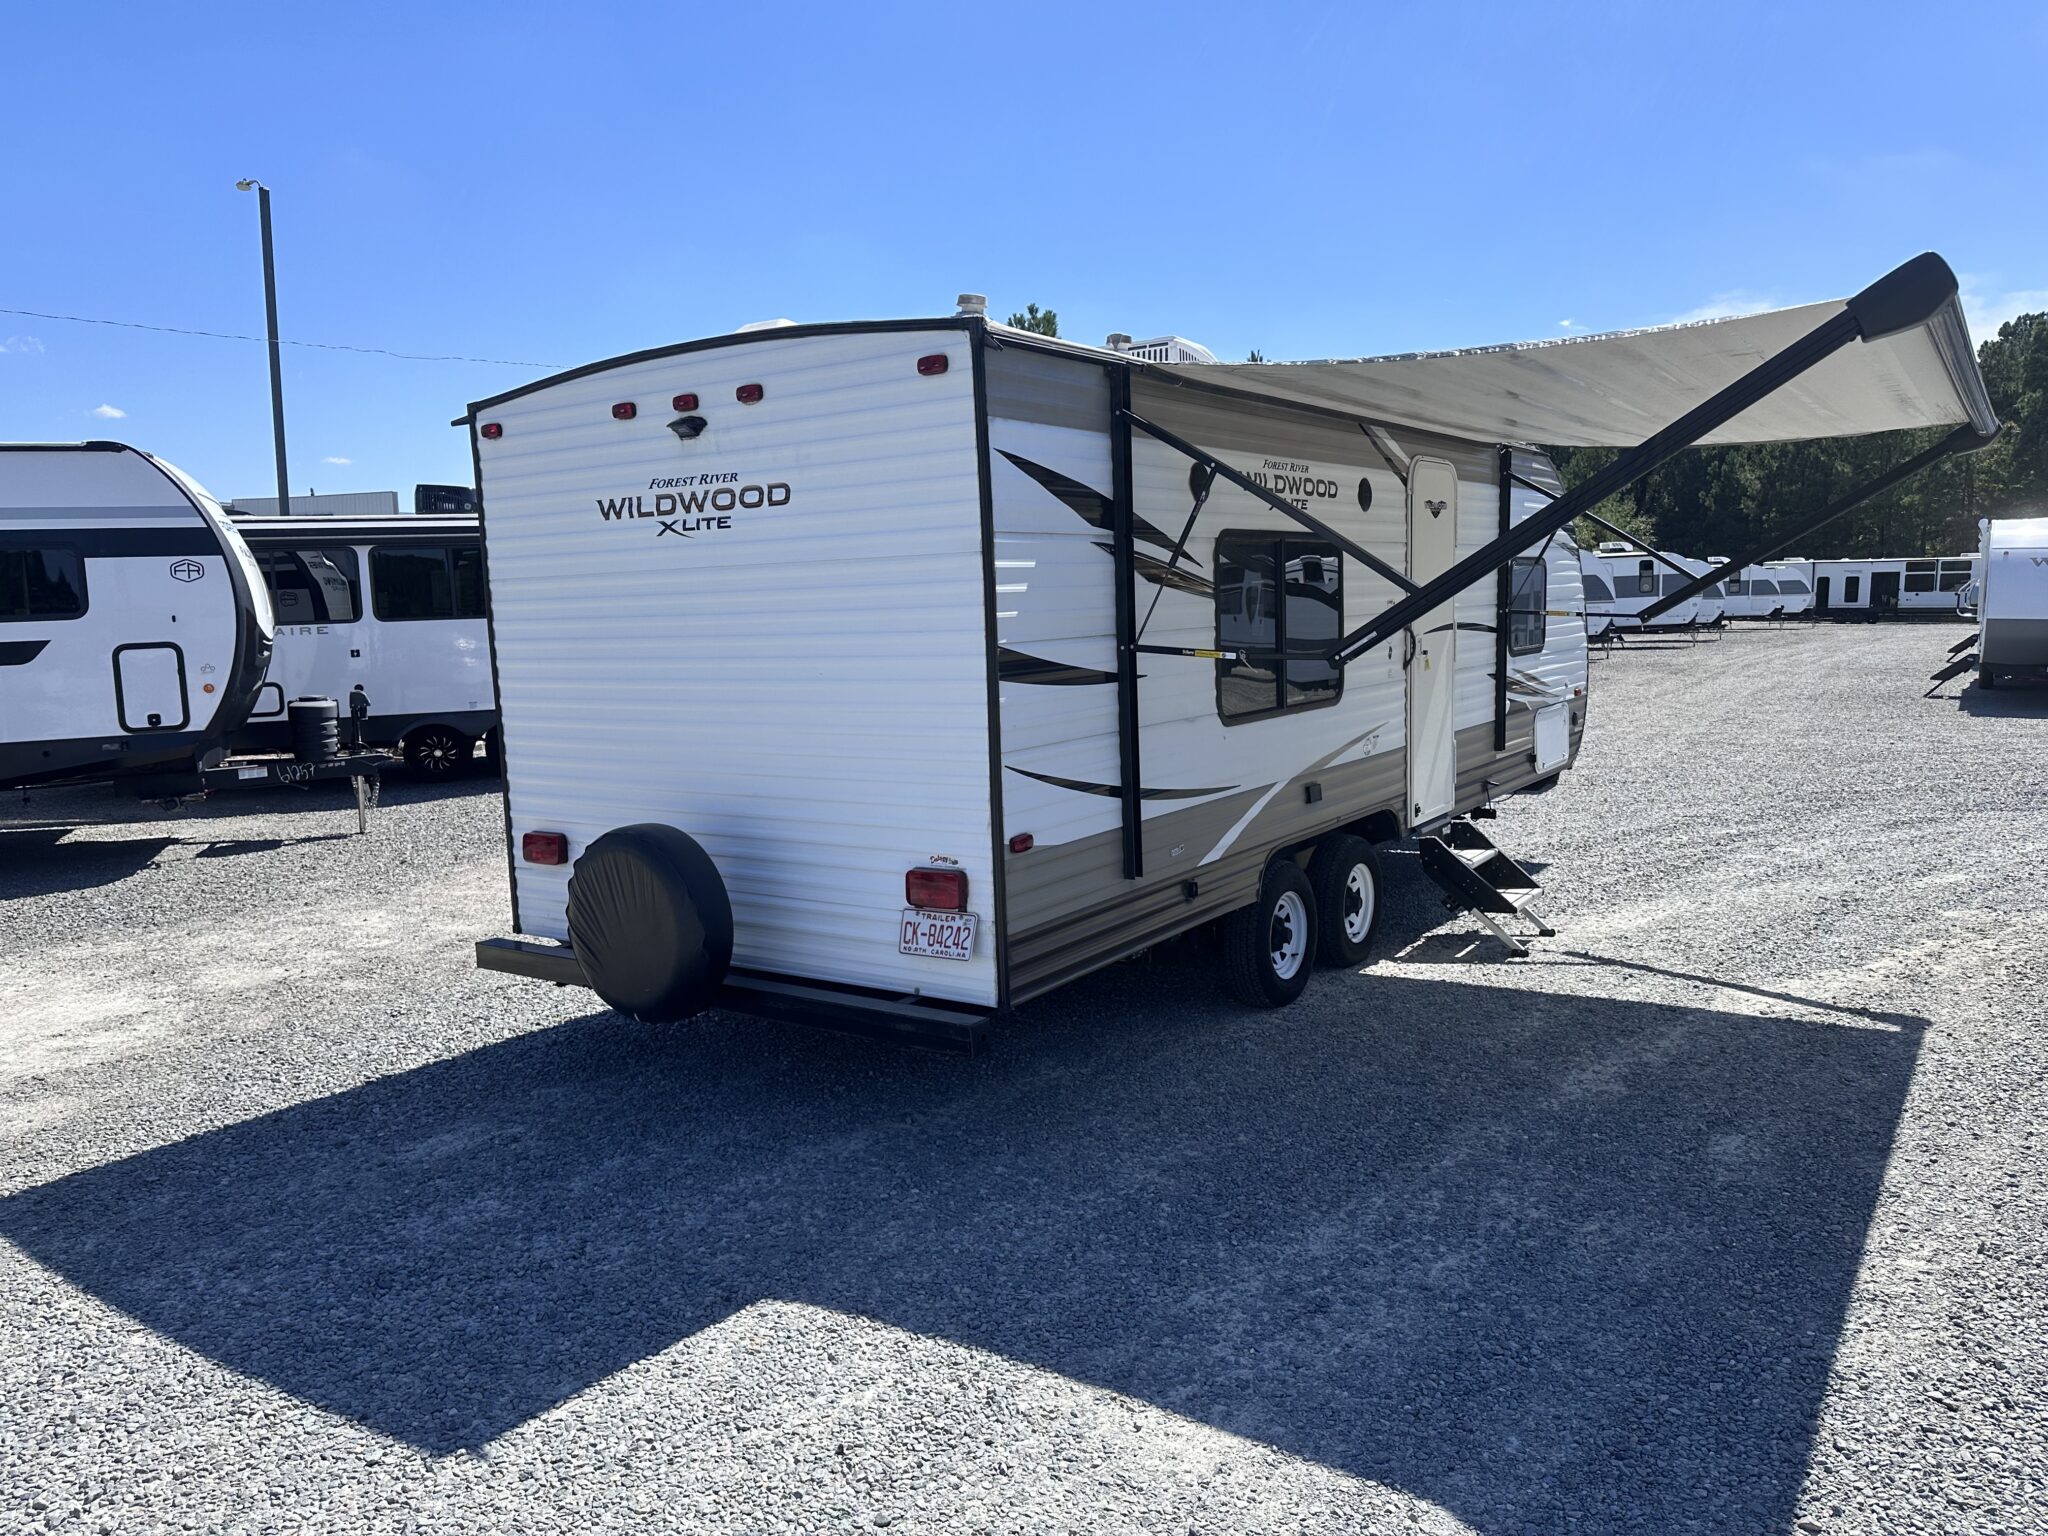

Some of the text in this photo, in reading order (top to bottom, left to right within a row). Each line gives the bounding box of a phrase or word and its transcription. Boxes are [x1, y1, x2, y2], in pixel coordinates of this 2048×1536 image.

[648, 472, 739, 490] FOREST RIVER
[595, 482, 792, 521] WILDWOOD
[276, 762, 316, 783] 61257
[921, 912, 957, 923] TRAILER
[903, 921, 971, 951] CK-84242
[902, 946, 966, 958] NORTH CAROLINA
